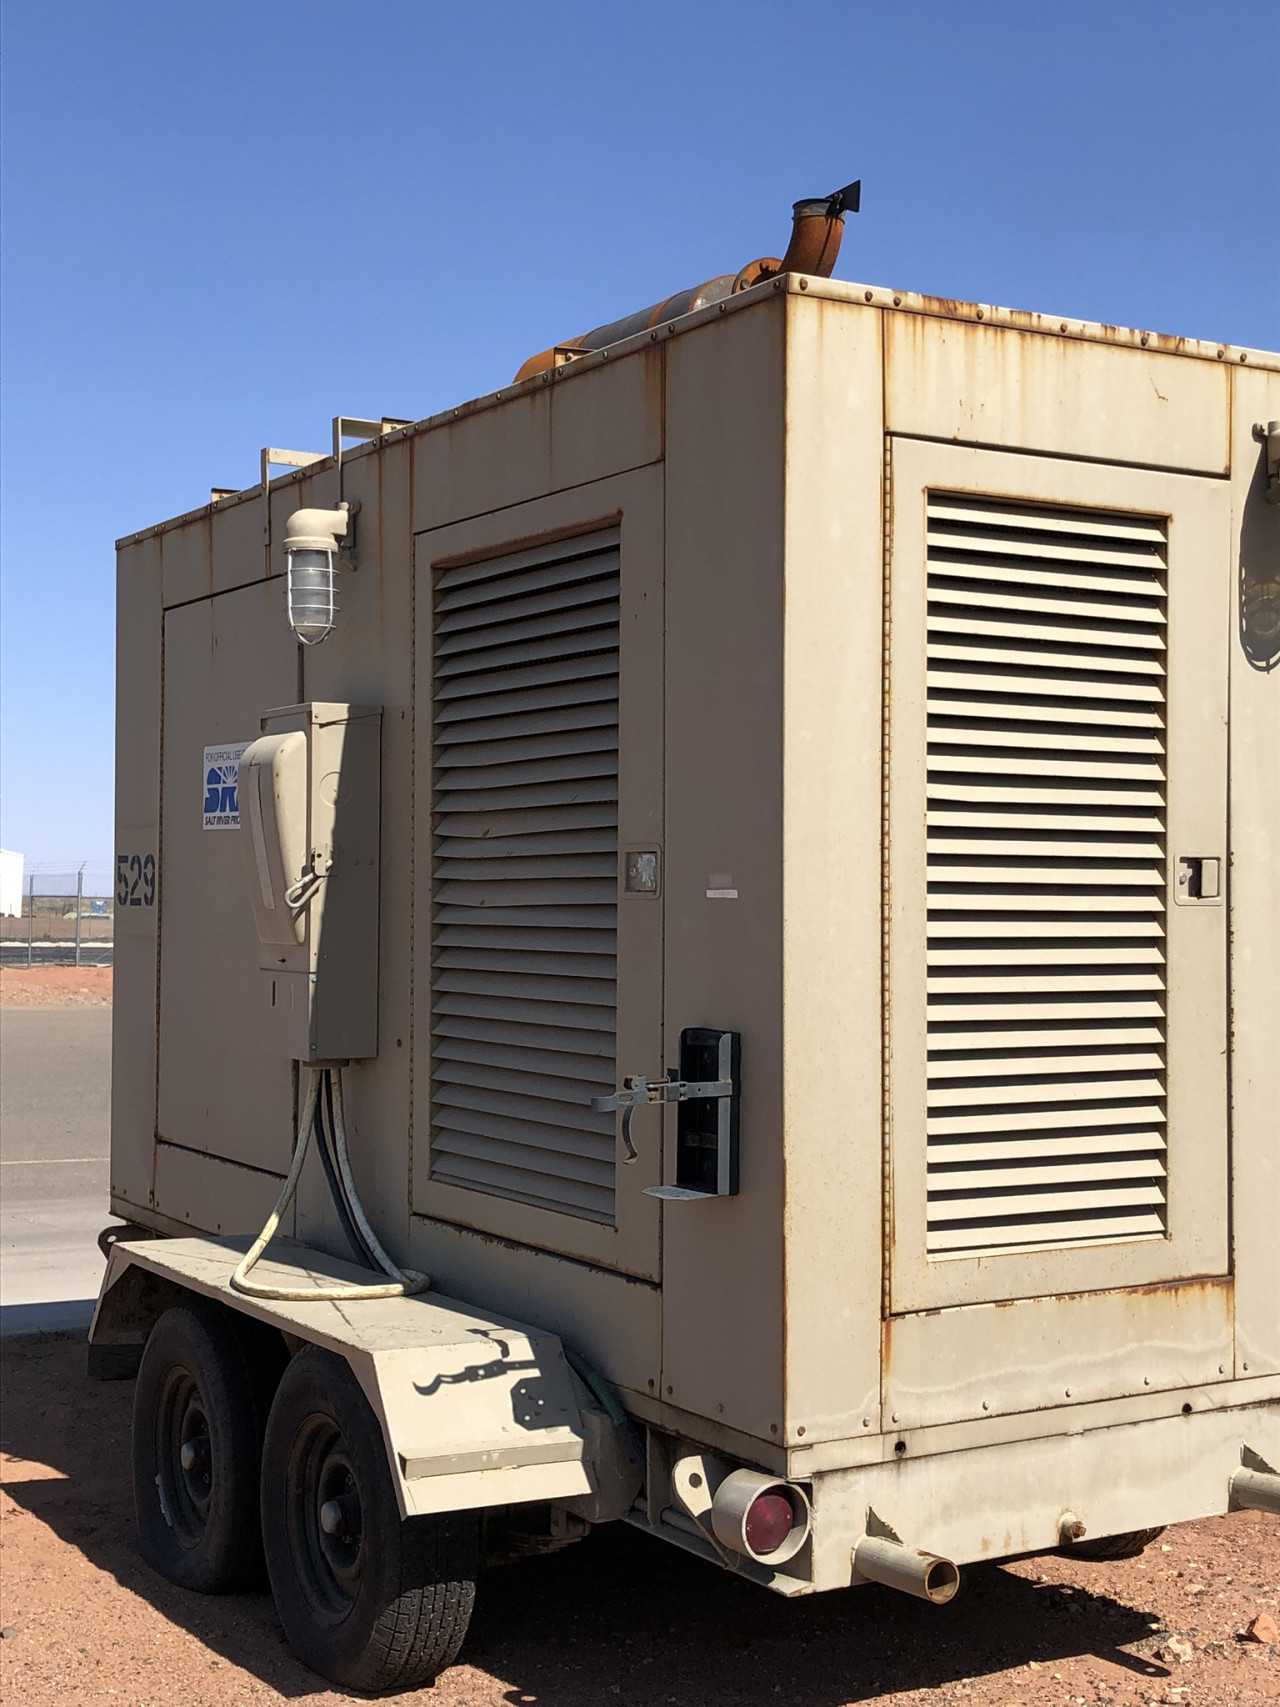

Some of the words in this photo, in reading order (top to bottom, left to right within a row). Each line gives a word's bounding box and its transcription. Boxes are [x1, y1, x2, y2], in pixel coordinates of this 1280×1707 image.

[204, 815, 216, 826] SALT
[216, 815, 230, 825] RIVER
[117, 854, 156, 906] 529
